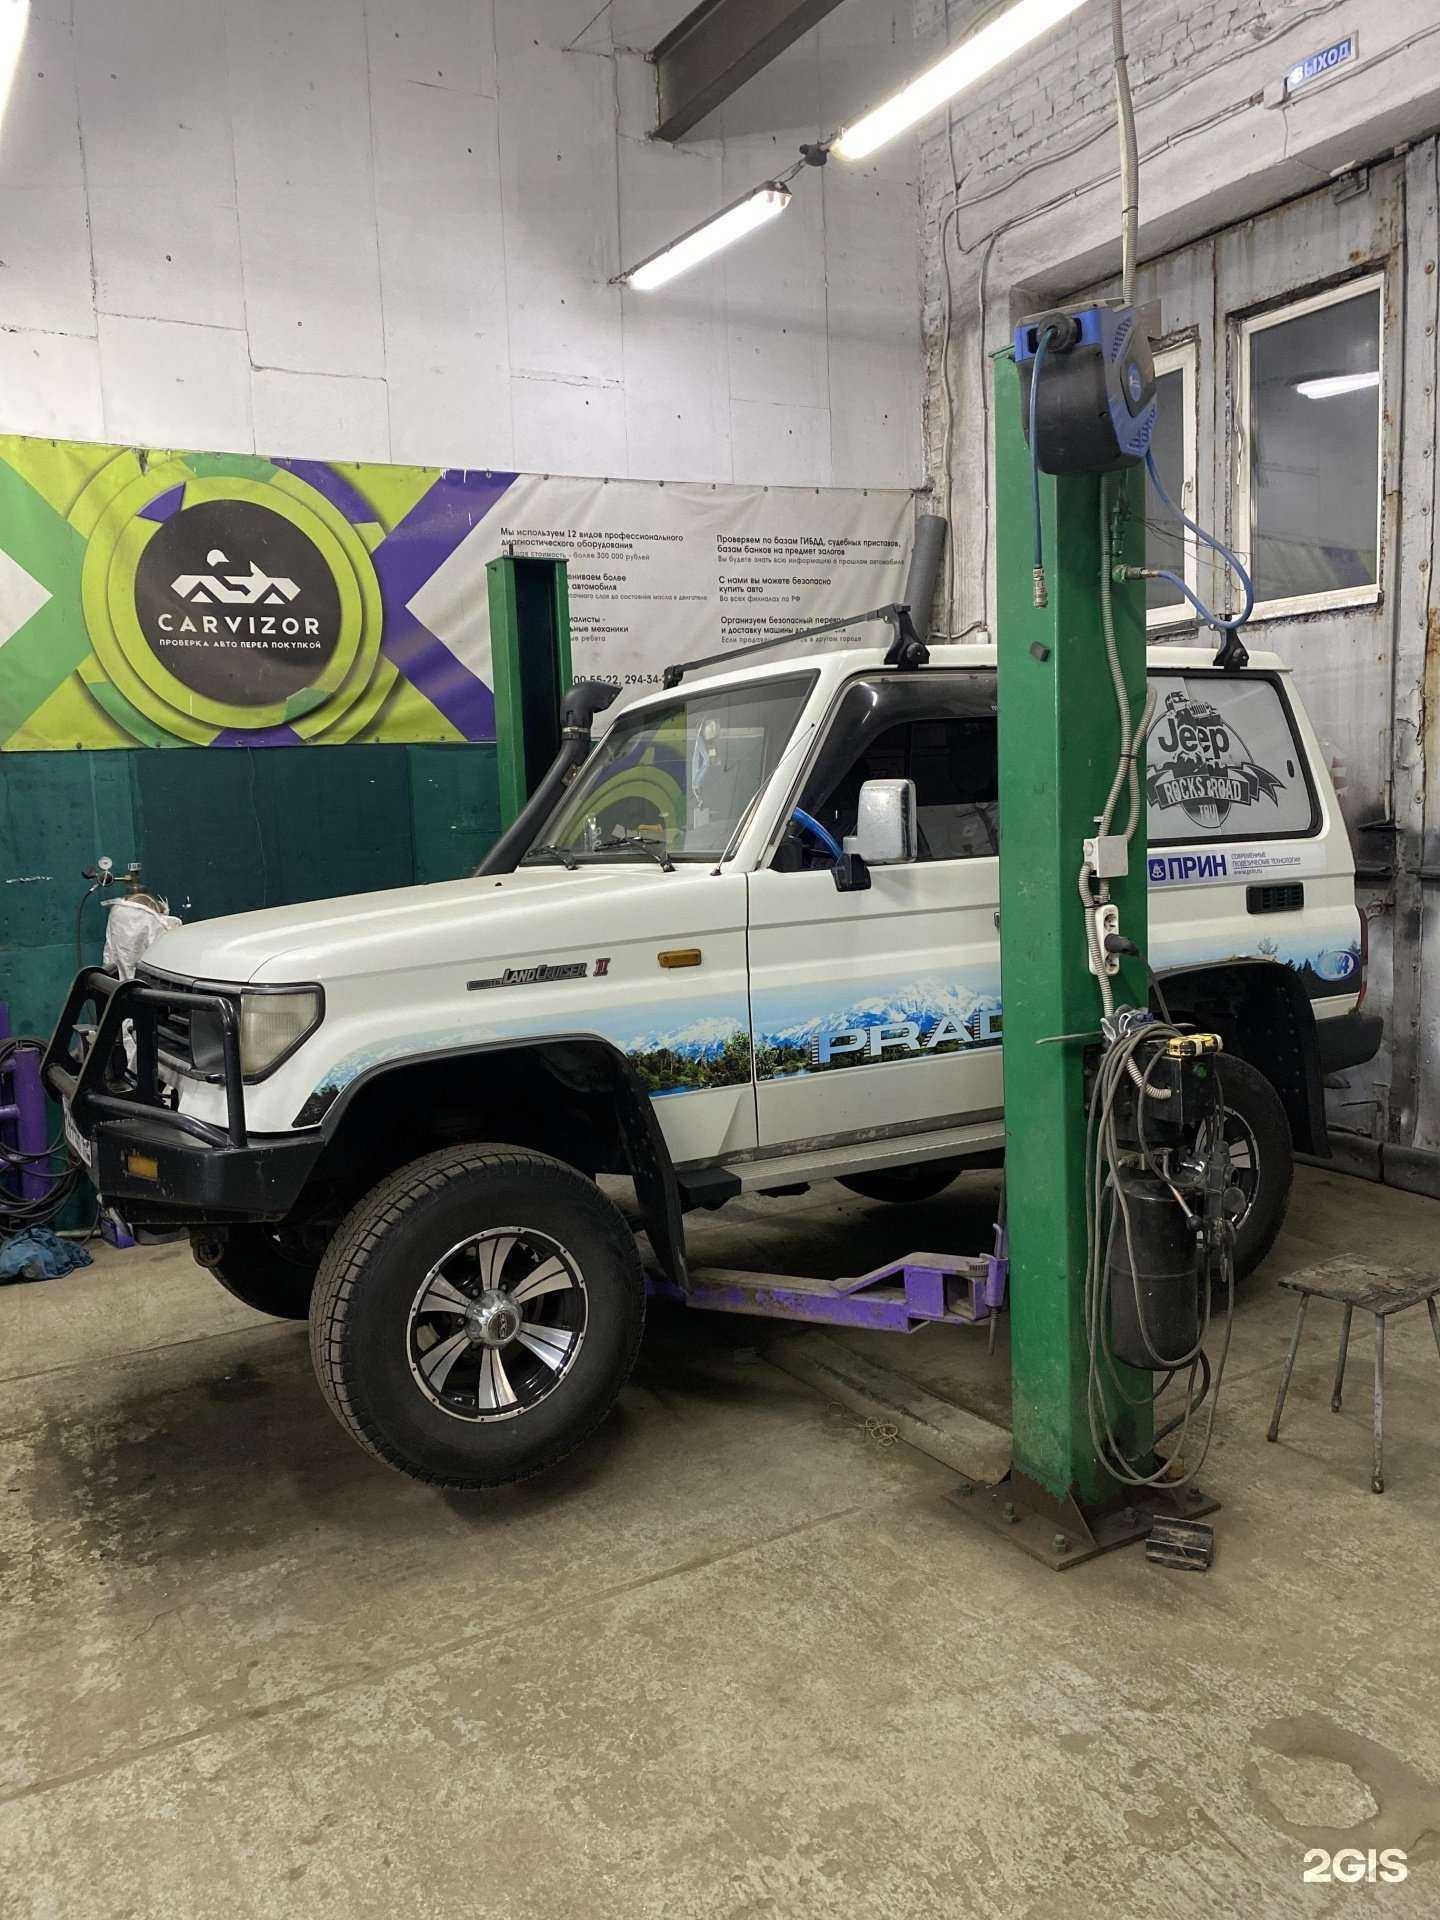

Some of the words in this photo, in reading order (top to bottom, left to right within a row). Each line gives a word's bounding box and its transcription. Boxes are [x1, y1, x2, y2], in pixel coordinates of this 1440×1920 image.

[1289, 42, 1349, 83] ЫХОД
[500, 528, 514, 536] Мы
[516, 529, 565, 539] используем
[567, 530, 577, 538] 12
[579, 531, 602, 539] видов
[604, 532, 684, 542] профессионального
[501, 539, 575, 547] диагностического
[577, 540, 633, 550] оборудования
[716, 535, 760, 544] Проверяем
[774, 536, 798, 544] базам
[800, 537, 825, 546] ГИБДД,
[828, 538, 862, 547] судебных
[717, 545, 742, 553] базам
[744, 546, 772, 554] банков
[785, 547, 816, 556] предмет
[603, 573, 626, 581] более
[718, 576, 726, 584] С
[792, 576, 832, 585] безопасно
[572, 583, 617, 591] автомобиля
[719, 586, 745, 594] купить
[158, 613, 320, 635] CARVIZOR
[720, 616, 767, 625] Организуем
[768, 616, 813, 624] безопасный
[728, 627, 762, 635] доставку
[159, 639, 209, 647] ПРОВЕРКА
[213, 640, 238, 648] АВТО
[271, 640, 321, 649] ПОКУПКОЙ
[1158, 717, 1230, 760] Jeep
[1163, 777, 1206, 804] ROCKS
[1167, 855, 1227, 880] ПРИН
